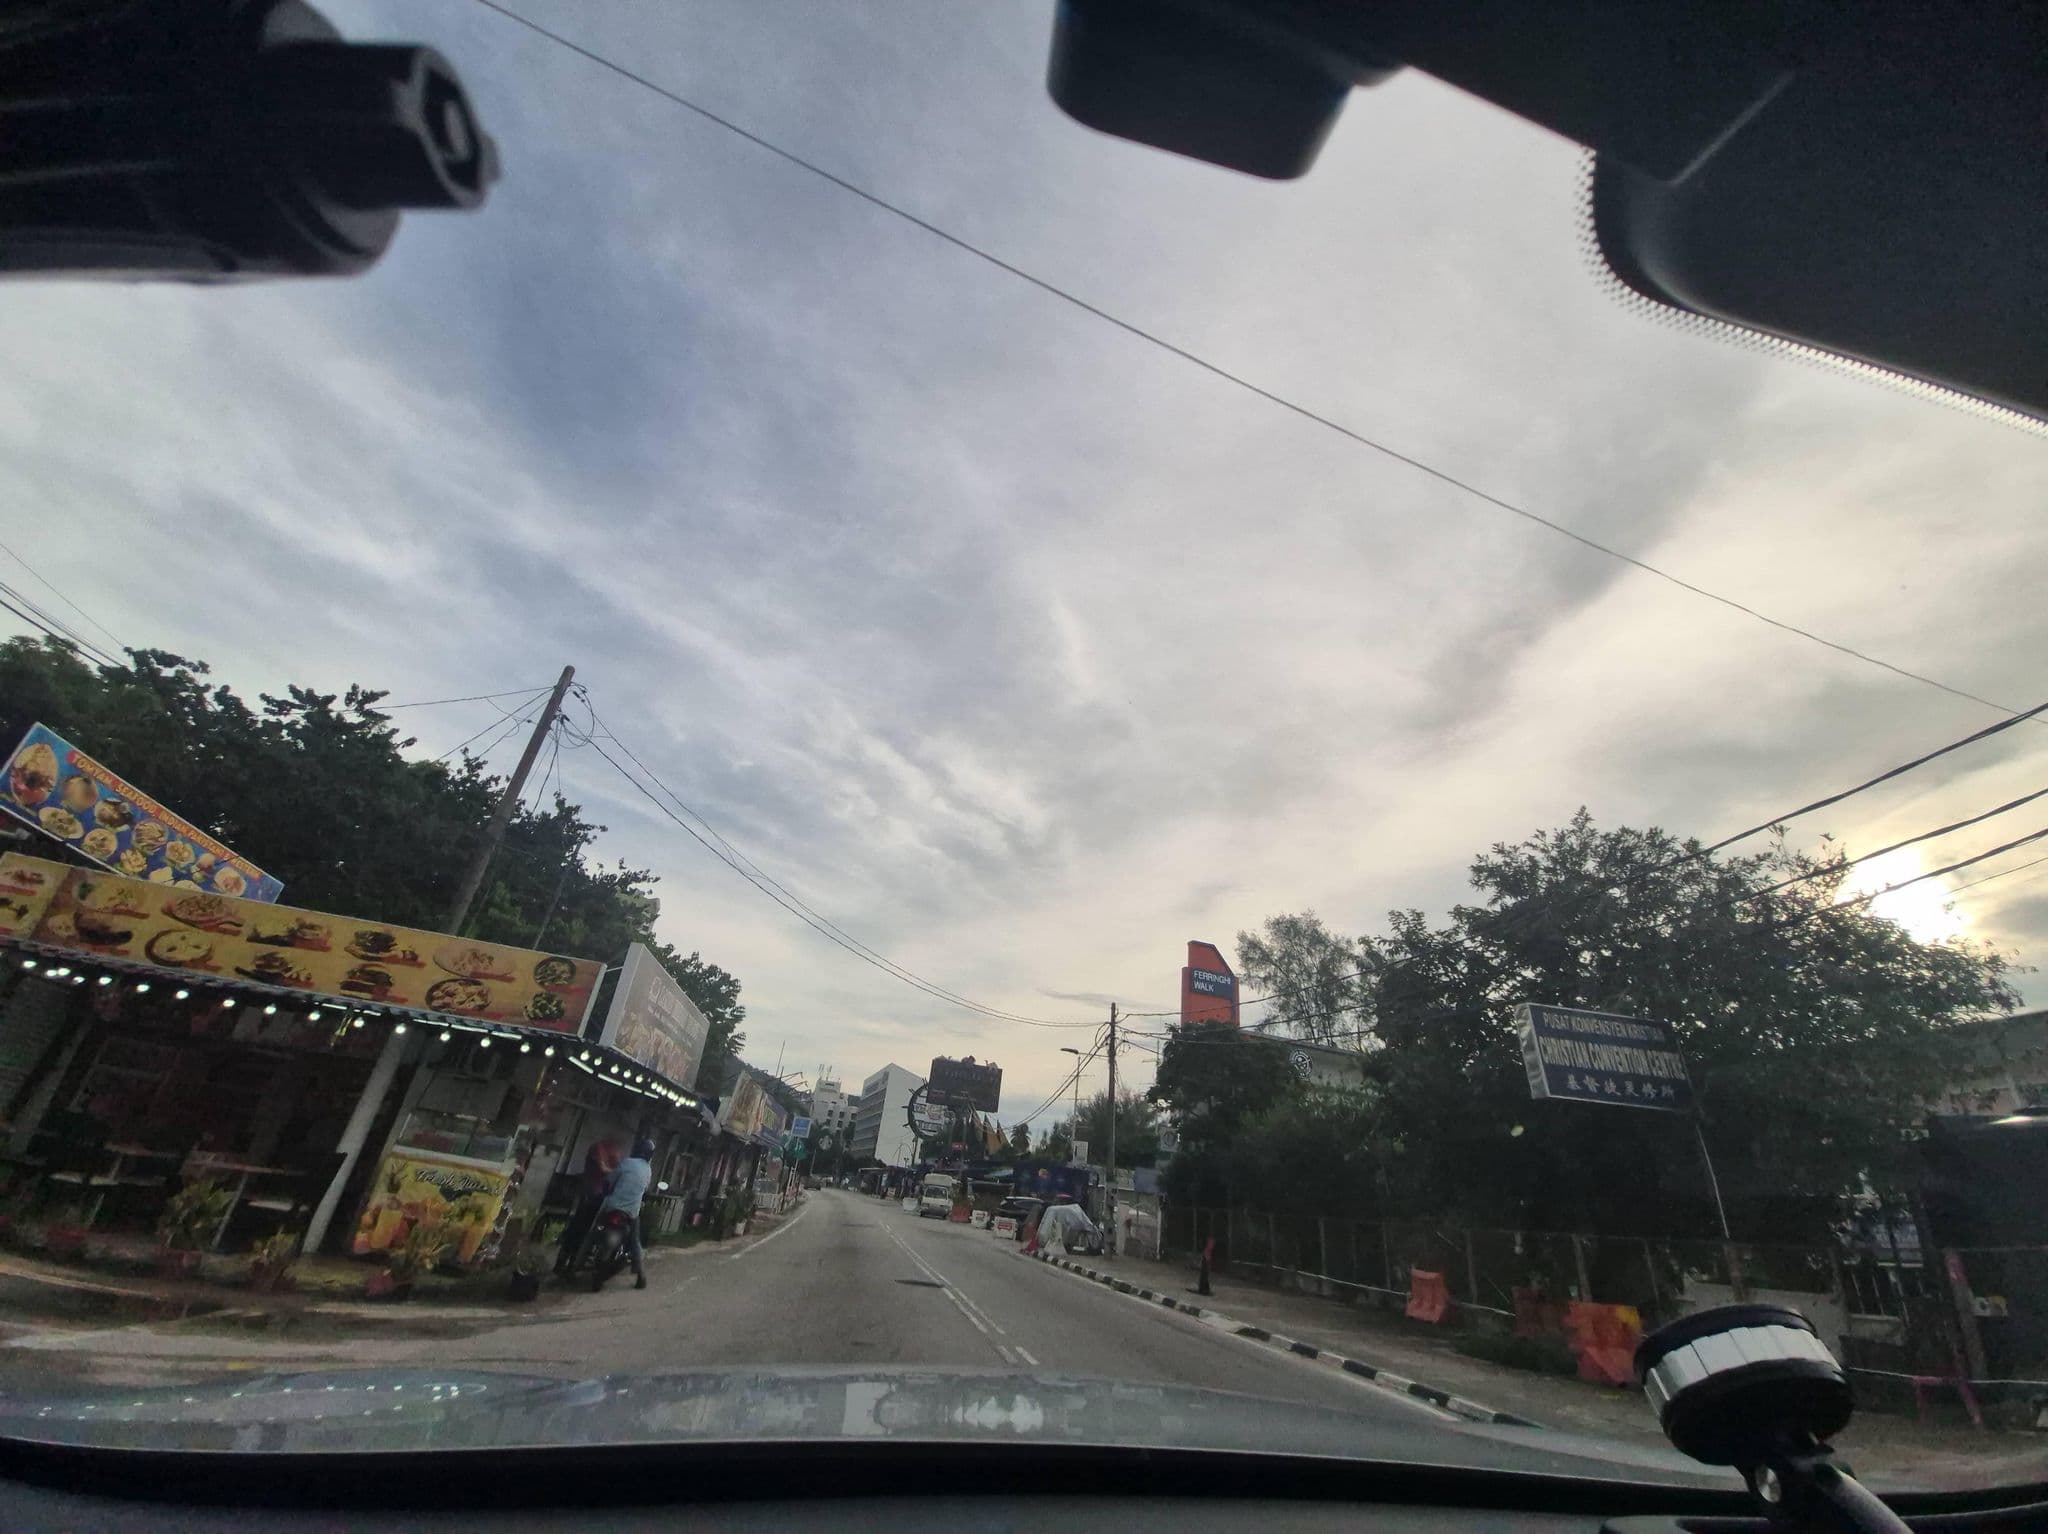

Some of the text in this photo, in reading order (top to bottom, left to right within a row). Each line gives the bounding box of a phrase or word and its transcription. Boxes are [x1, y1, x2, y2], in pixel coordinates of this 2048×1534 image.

[1193, 970, 1231, 985] FERRINGHI
[1193, 981, 1214, 993] WALK
[1543, 1012, 1569, 1028] PUSAT
[1538, 1035, 1591, 1068] CHRISTIAN
[1589, 1042, 1652, 1075] CONVENTION
